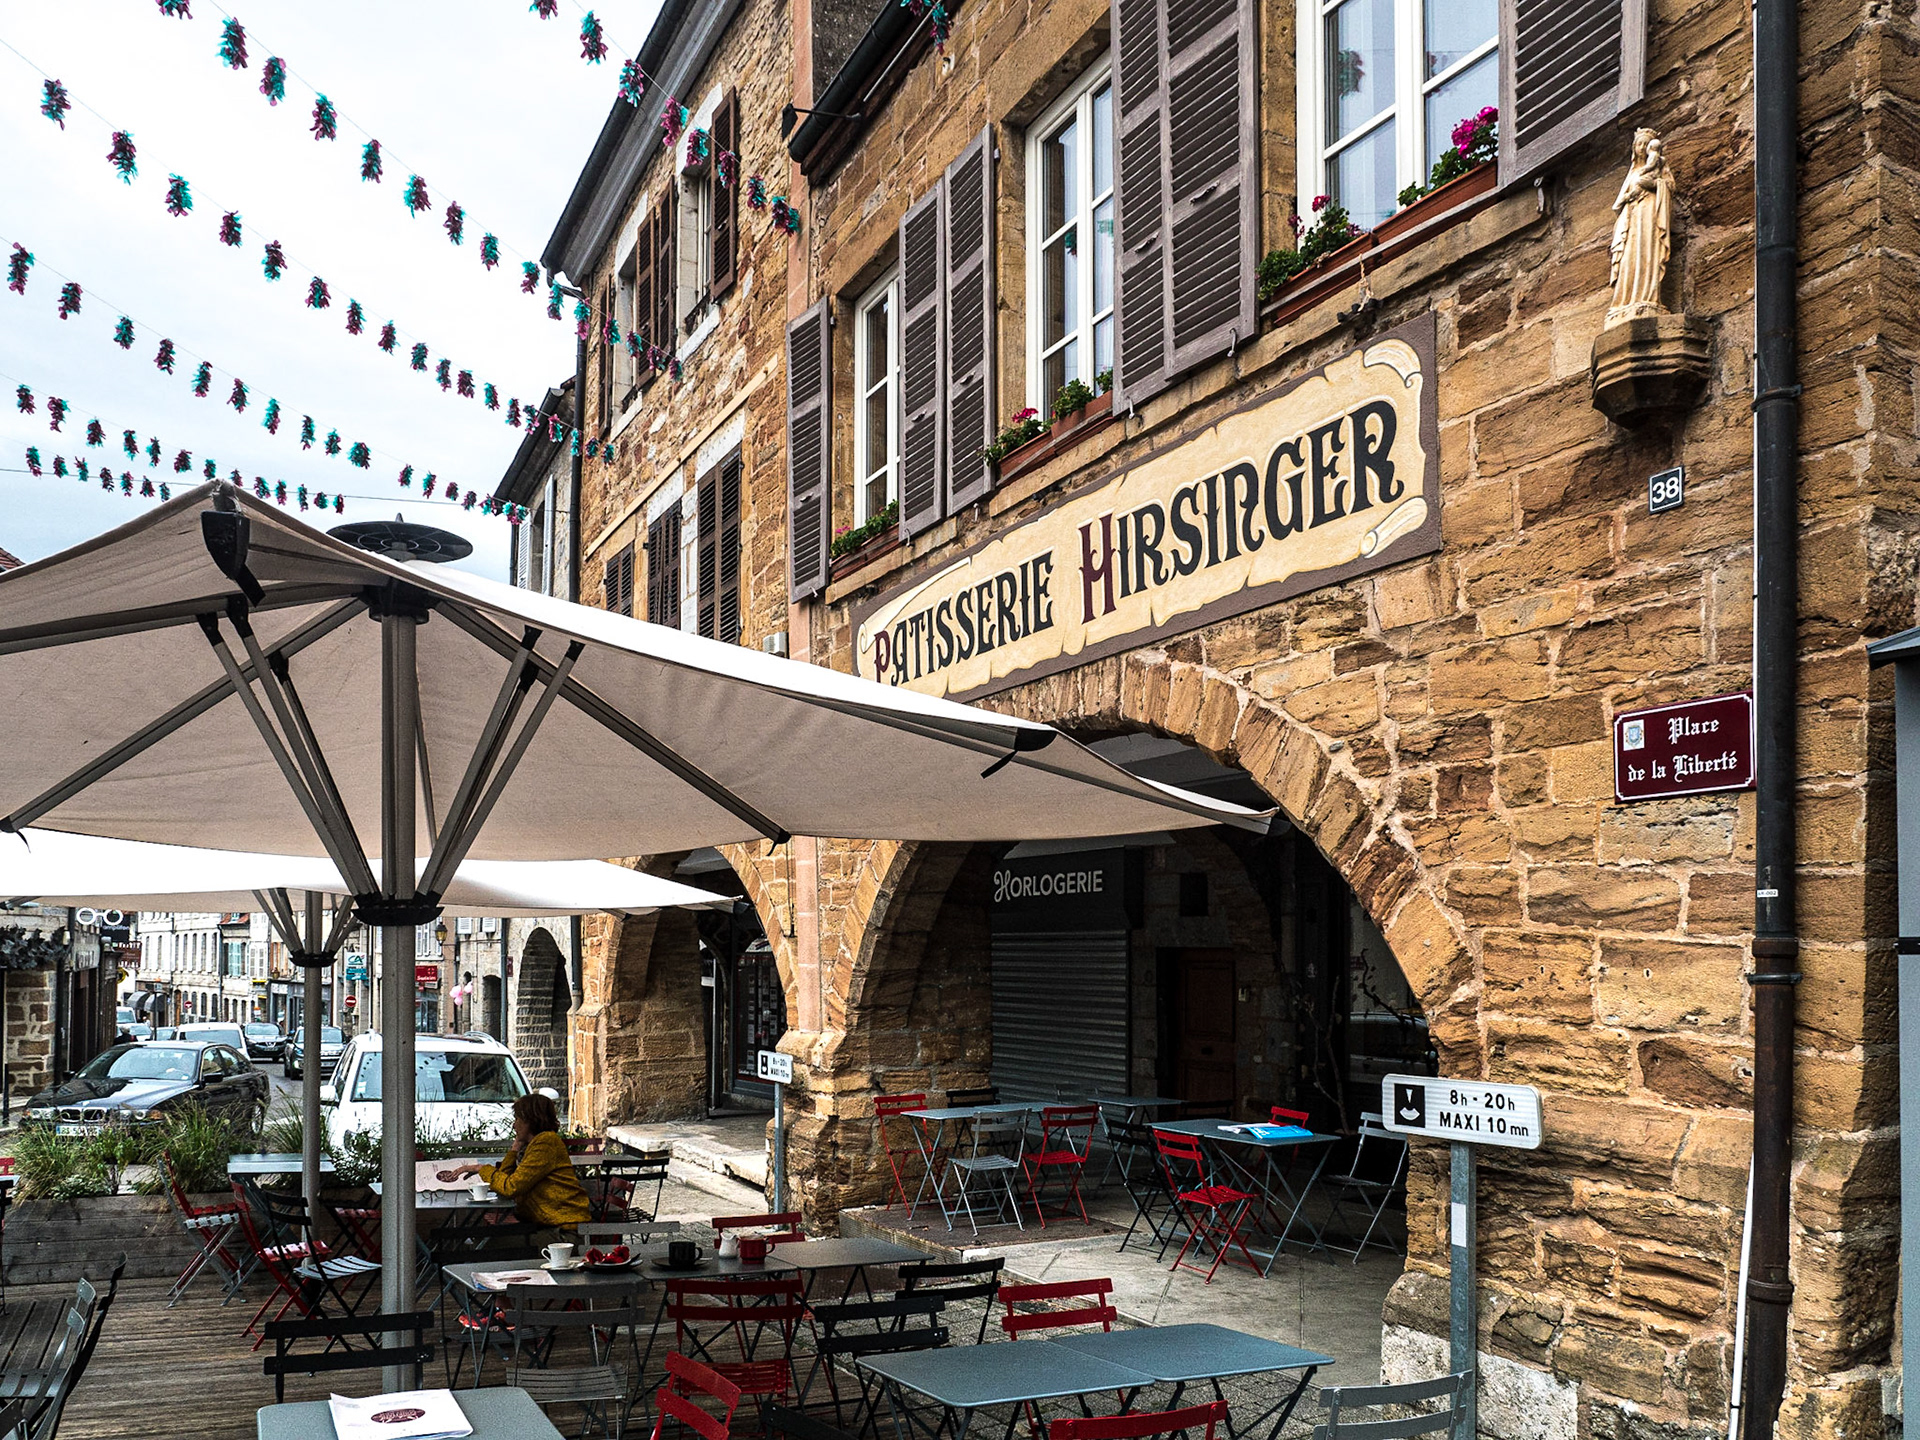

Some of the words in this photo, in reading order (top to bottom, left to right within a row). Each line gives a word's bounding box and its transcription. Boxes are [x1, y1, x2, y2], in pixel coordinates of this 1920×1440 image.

[1652, 476, 1680, 504] 38
[874, 548, 1054, 687] PATISSERIE
[1079, 400, 1406, 624] HIRSINGER
[1667, 717, 1720, 745] Place
[1627, 763, 1646, 783] de
[1651, 760, 1667, 780] la
[1672, 750, 1738, 783] Liberté
[993, 869, 1104, 903] HORLOGERIE
[1449, 1089, 1468, 1107] 8h
[1484, 1092, 1515, 1111] 20h
[1439, 1111, 1480, 1131] MAXI
[1487, 1117, 1507, 1134] 10
[1510, 1125, 1529, 1137] mn
